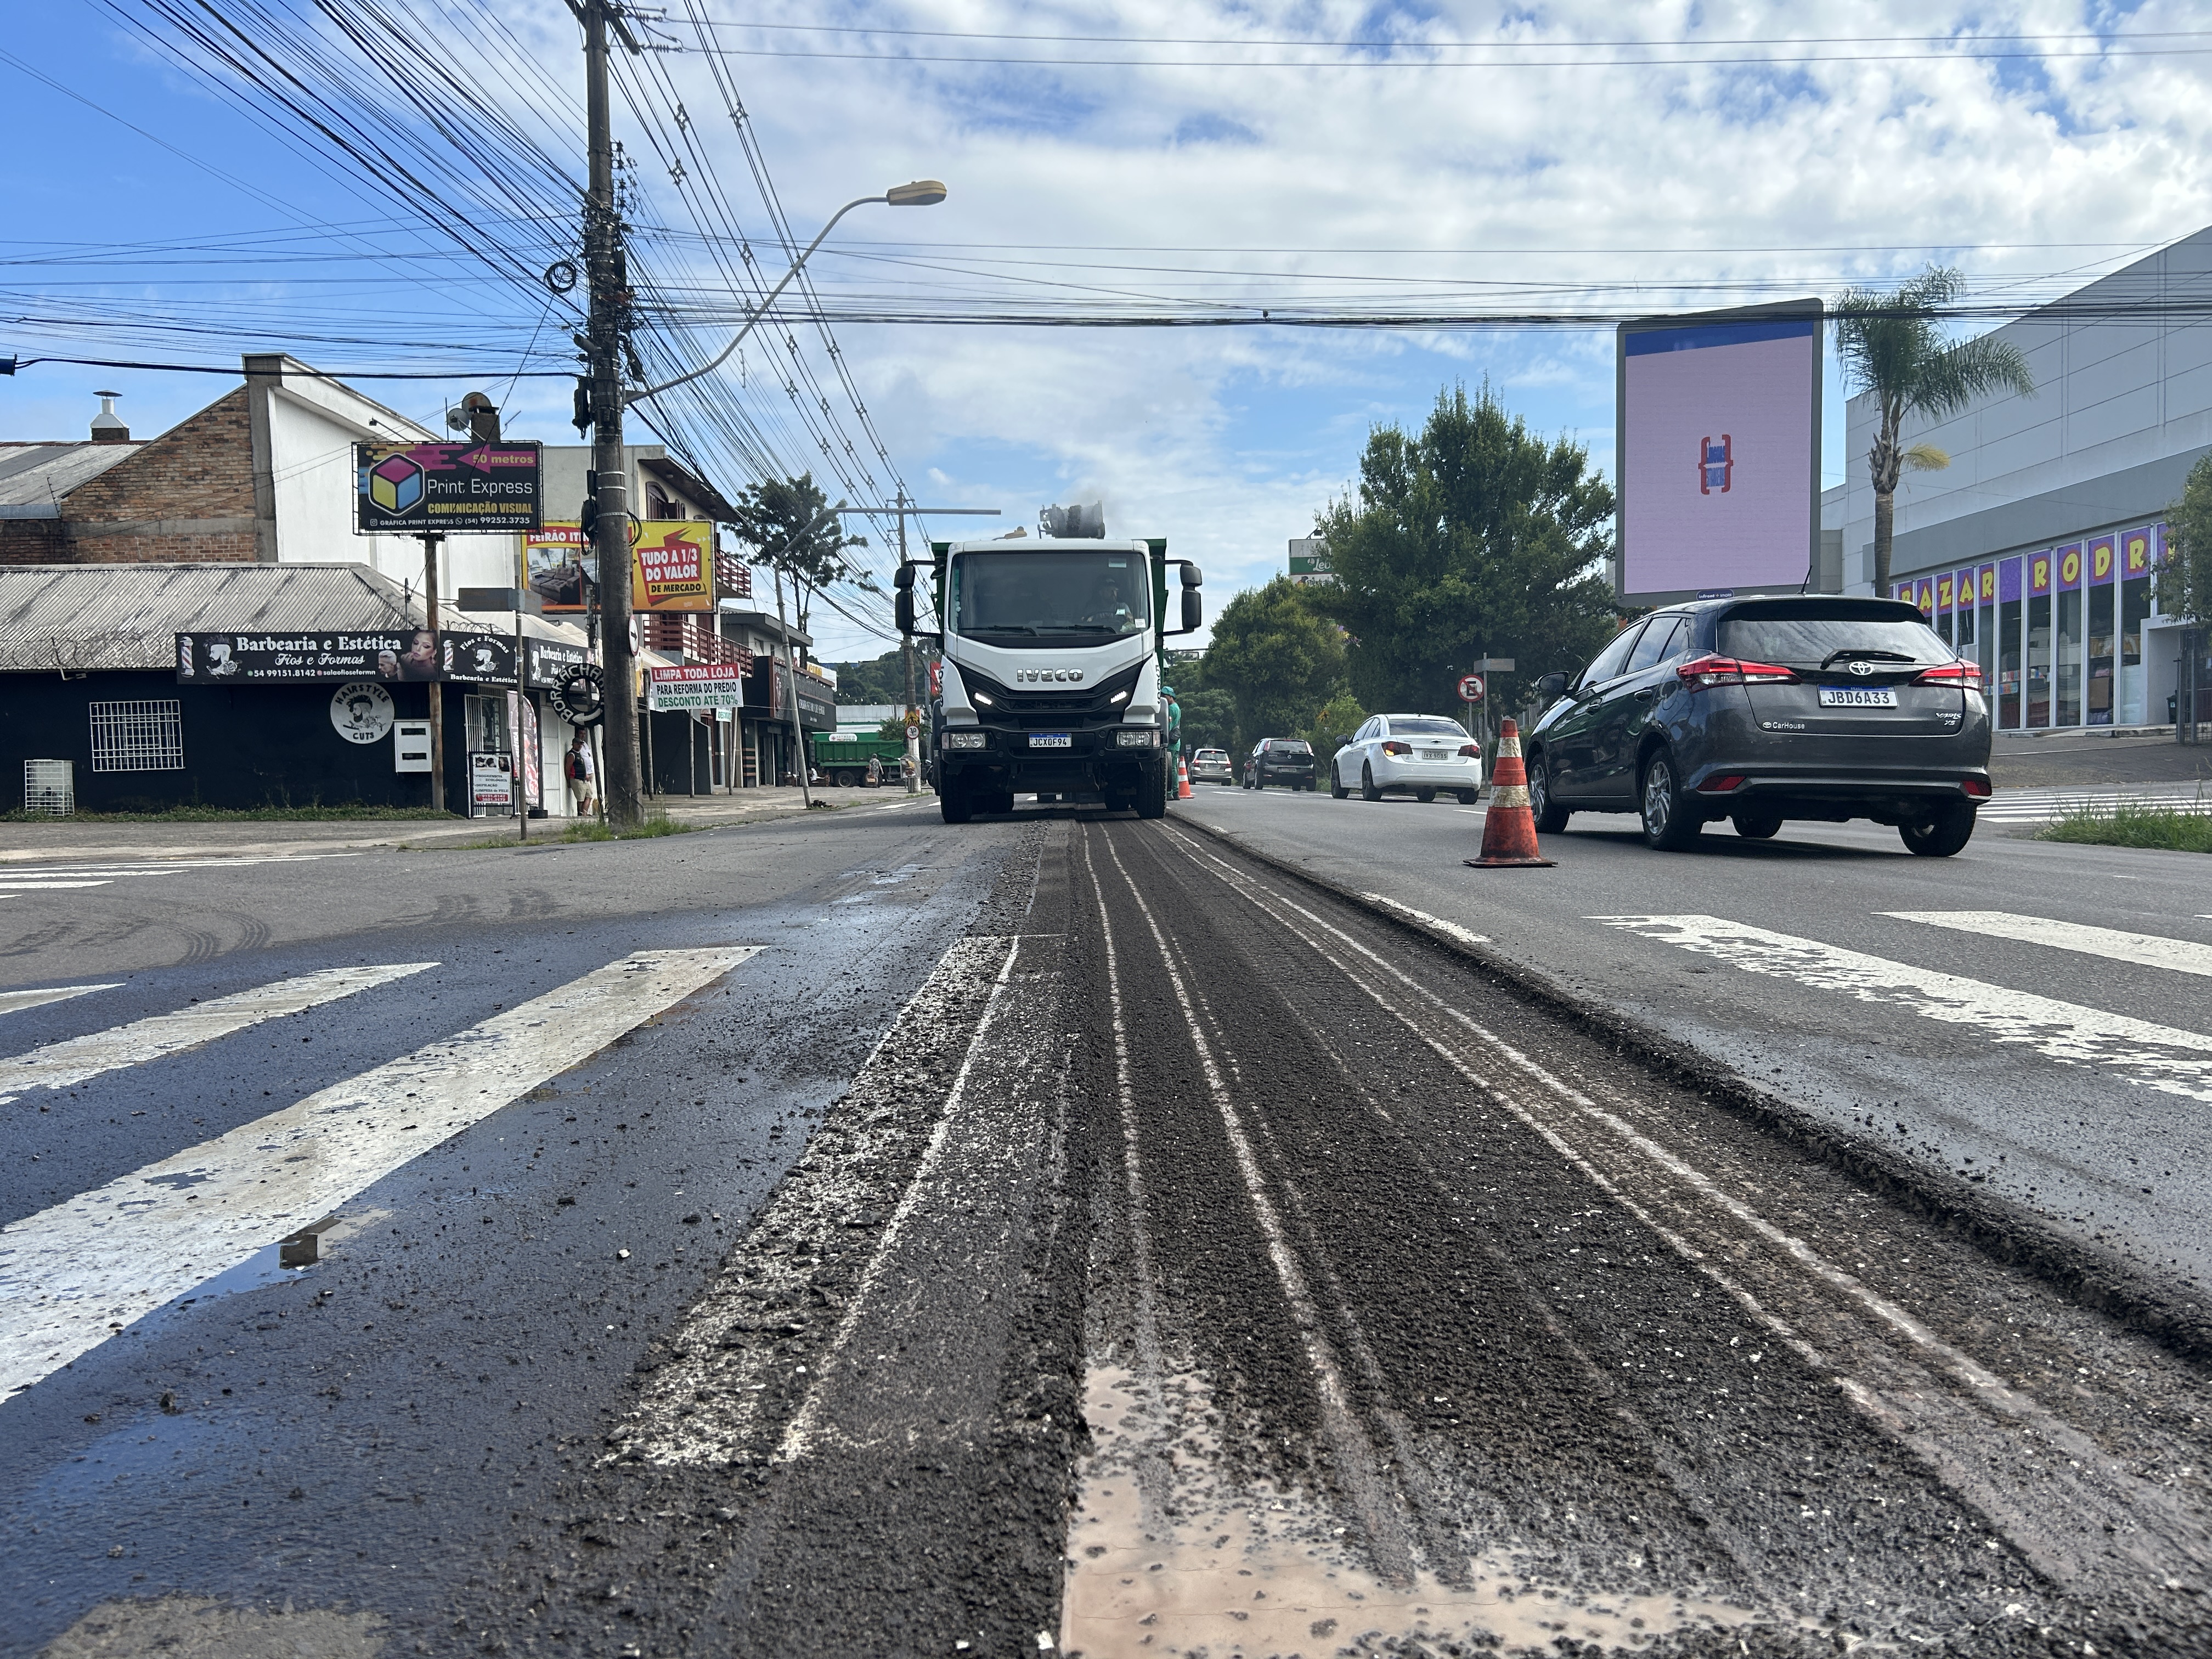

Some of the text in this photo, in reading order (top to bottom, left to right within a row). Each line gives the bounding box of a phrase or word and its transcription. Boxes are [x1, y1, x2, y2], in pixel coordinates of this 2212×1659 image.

[473, 454, 534, 464] 50 metros
[427, 478, 533, 497] Print Express
[427, 501, 533, 516] COMUNICAÇÃO VISUAL
[530, 530, 567, 542] FEIRÃO
[641, 548, 698, 566] TUDO A 1/3
[2034, 538, 2175, 588] RODR
[646, 564, 698, 582] DO VALOR
[651, 583, 702, 592] DE MERCADO
[236, 635, 402, 651] Barbearia e Estética
[460, 638, 475, 651] Fios
[484, 635, 509, 654] Formas
[275, 652, 365, 666] Fios e Formas
[540, 645, 562, 662] Barbearia
[566, 650, 583, 664] Estética
[450, 674, 484, 682] Barbearia
[654, 667, 735, 681] LIMPA TODA LOJA
[1016, 668, 1084, 683] IVECO
[335, 684, 390, 705] HAIRSTYLE
[657, 680, 737, 696] PARA REFORMA DO PRÉDIO
[658, 693, 738, 708] DESCONTO ATÉ 70%
[1828, 691, 1890, 704] JBD6A33
[353, 732, 375, 740] CUTS
